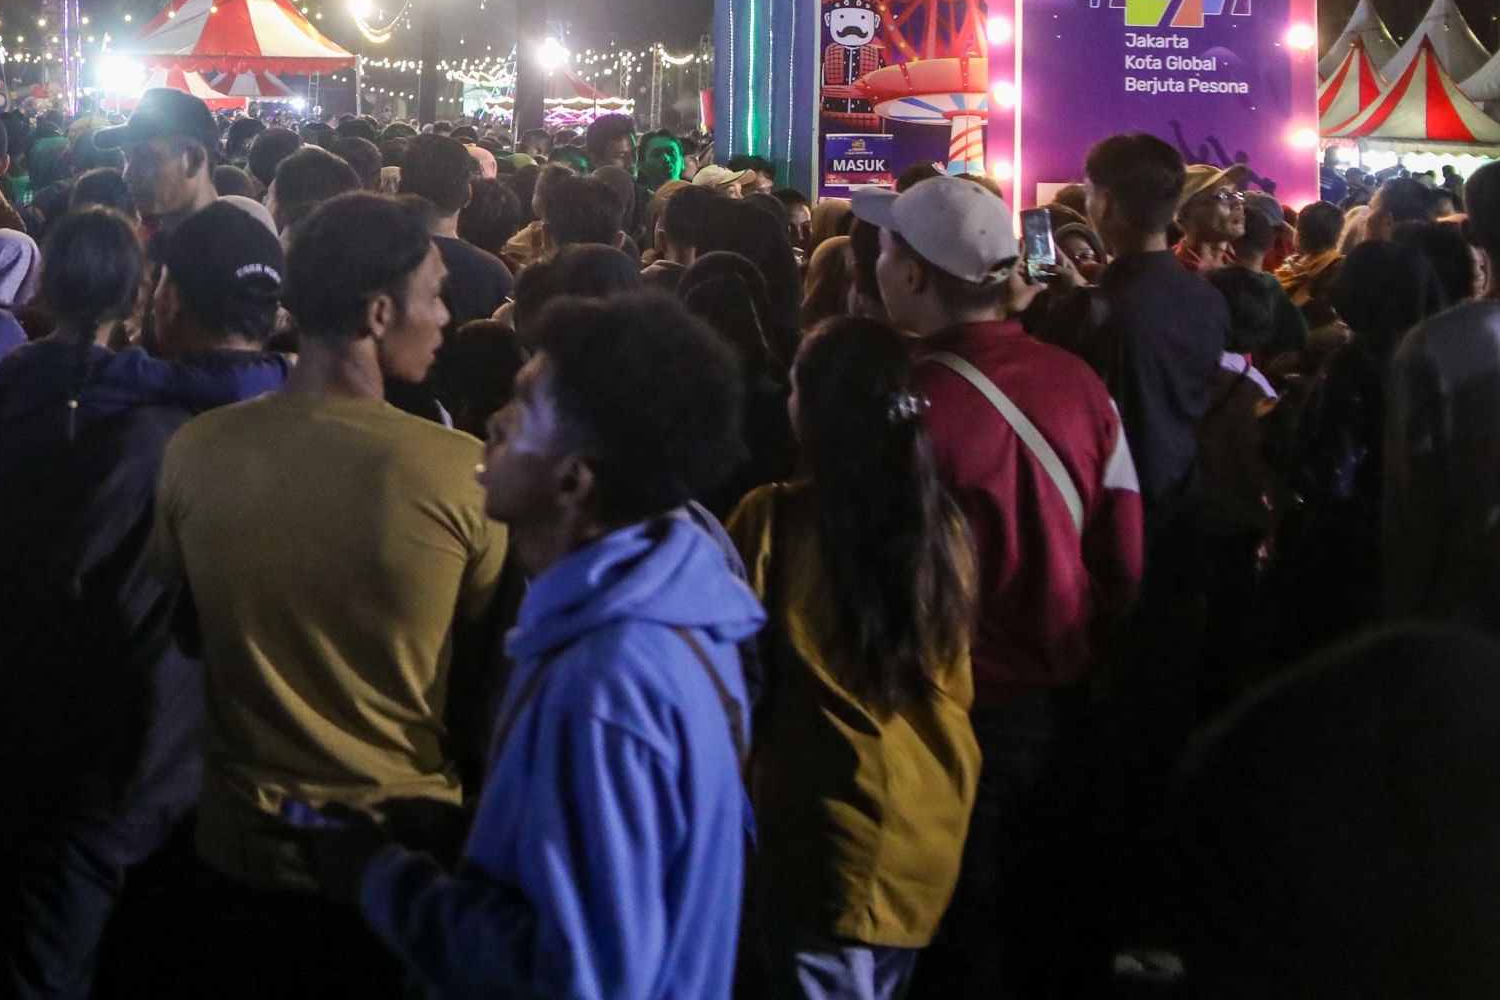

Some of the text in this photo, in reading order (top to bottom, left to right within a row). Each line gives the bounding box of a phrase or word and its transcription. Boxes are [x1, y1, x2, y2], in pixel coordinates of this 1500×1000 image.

[1125, 33, 1189, 49] Jakarta
[1125, 55, 1217, 71] Kota Global
[1125, 77, 1249, 95] Berjuta Pesona
[833, 159, 886, 172] MASUK
